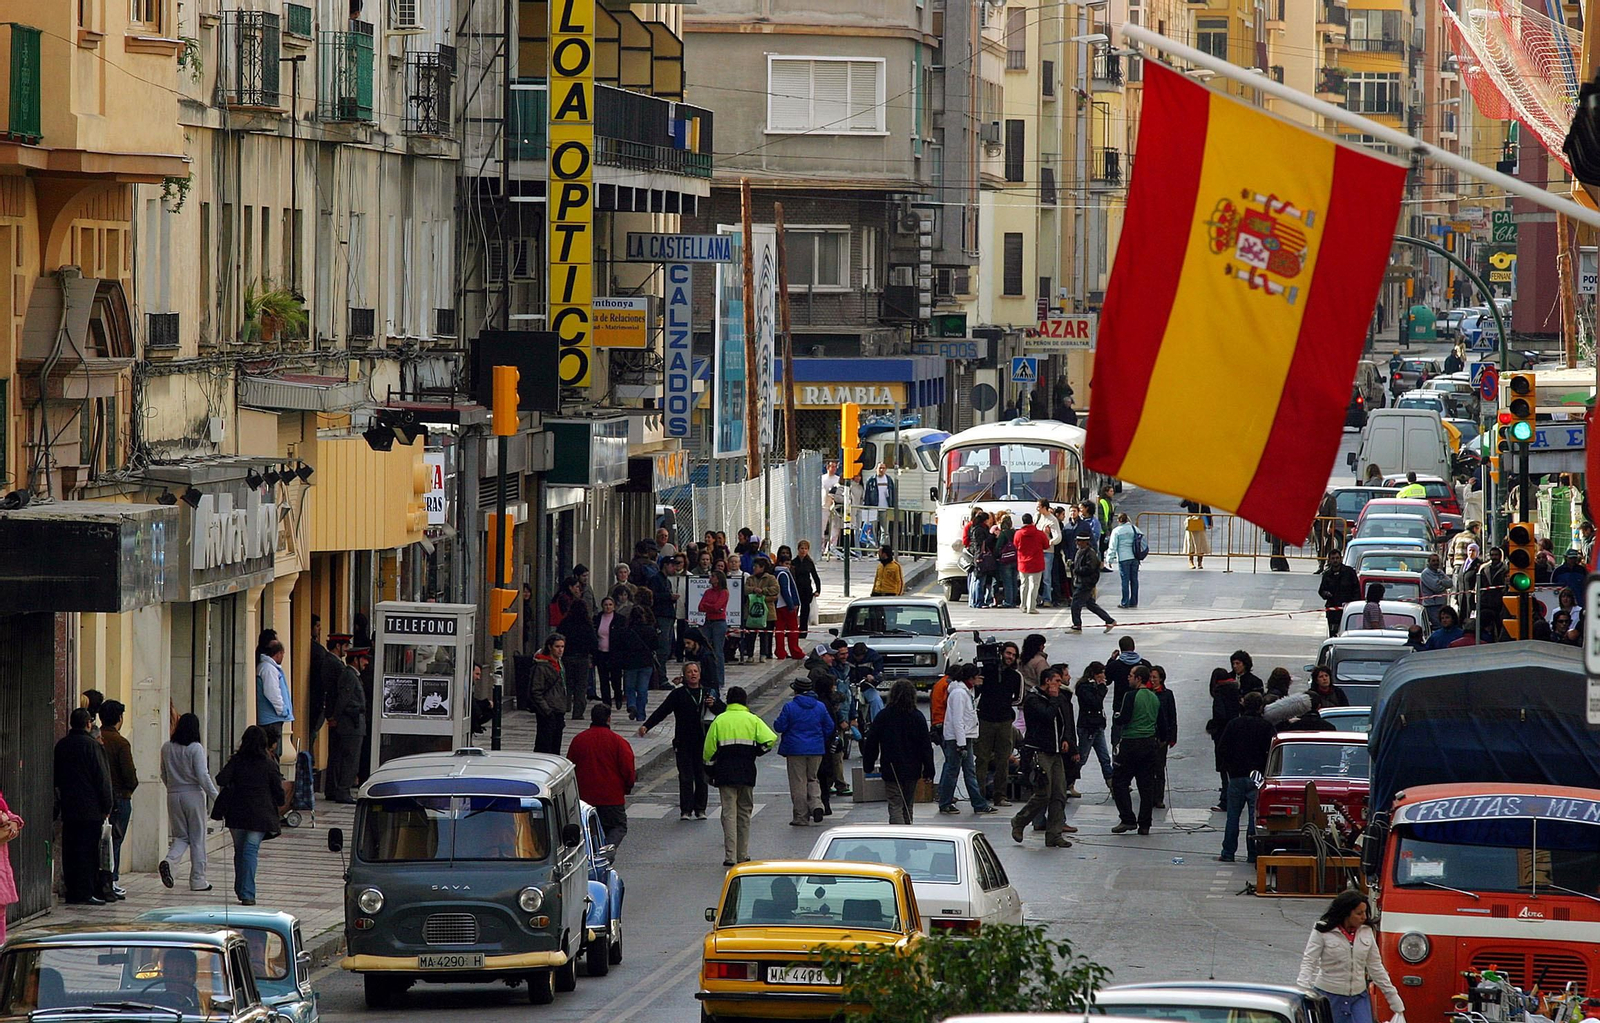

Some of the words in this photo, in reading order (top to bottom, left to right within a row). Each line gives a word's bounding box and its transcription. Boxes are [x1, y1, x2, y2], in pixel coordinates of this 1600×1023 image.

[628, 235, 644, 258] LA
[650, 236, 731, 260] CASTELLANA
[552, 141, 591, 386] OPTICO
[669, 265, 689, 436] CALZADOS
[805, 386, 896, 405] RAMBLA
[387, 618, 454, 634] TELEFONO
[1416, 797, 1523, 821] FRUTAS
[474, 955, 481, 966] H
